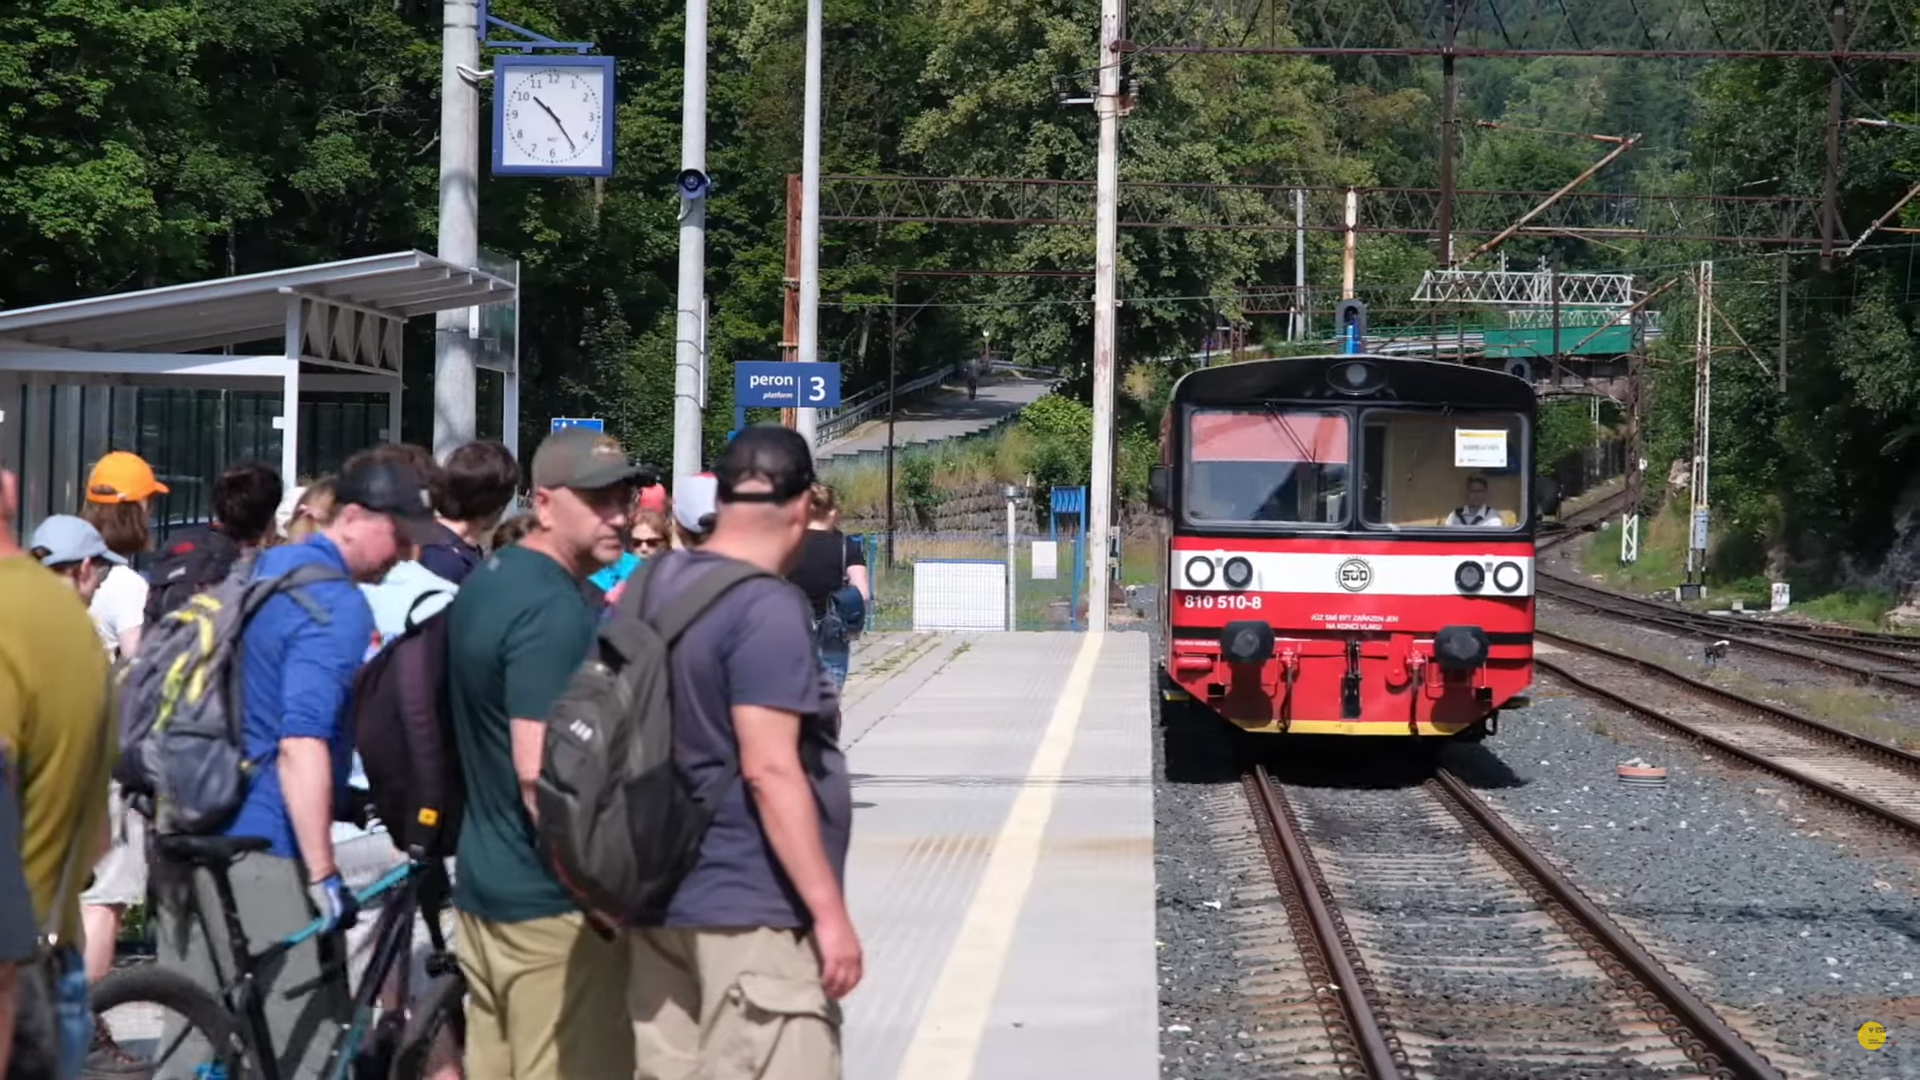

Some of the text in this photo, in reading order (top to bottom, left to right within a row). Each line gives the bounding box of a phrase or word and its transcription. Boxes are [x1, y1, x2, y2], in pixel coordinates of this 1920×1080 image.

[548, 74, 560, 83] 12
[530, 79, 542, 89] 11
[570, 80, 577, 89] 1
[517, 92, 530, 101] 10
[582, 93, 589, 102] 2
[511, 110, 518, 119] 9
[588, 112, 595, 122] 3
[516, 129, 523, 139] 8
[582, 131, 589, 140] 4
[531, 143, 537, 153] 7
[549, 149, 556, 158] 6
[749, 375, 793, 389] peron
[809, 376, 826, 402] 3
[762, 391, 793, 400] platform
[1185, 595, 1262, 609] 810 510-8
